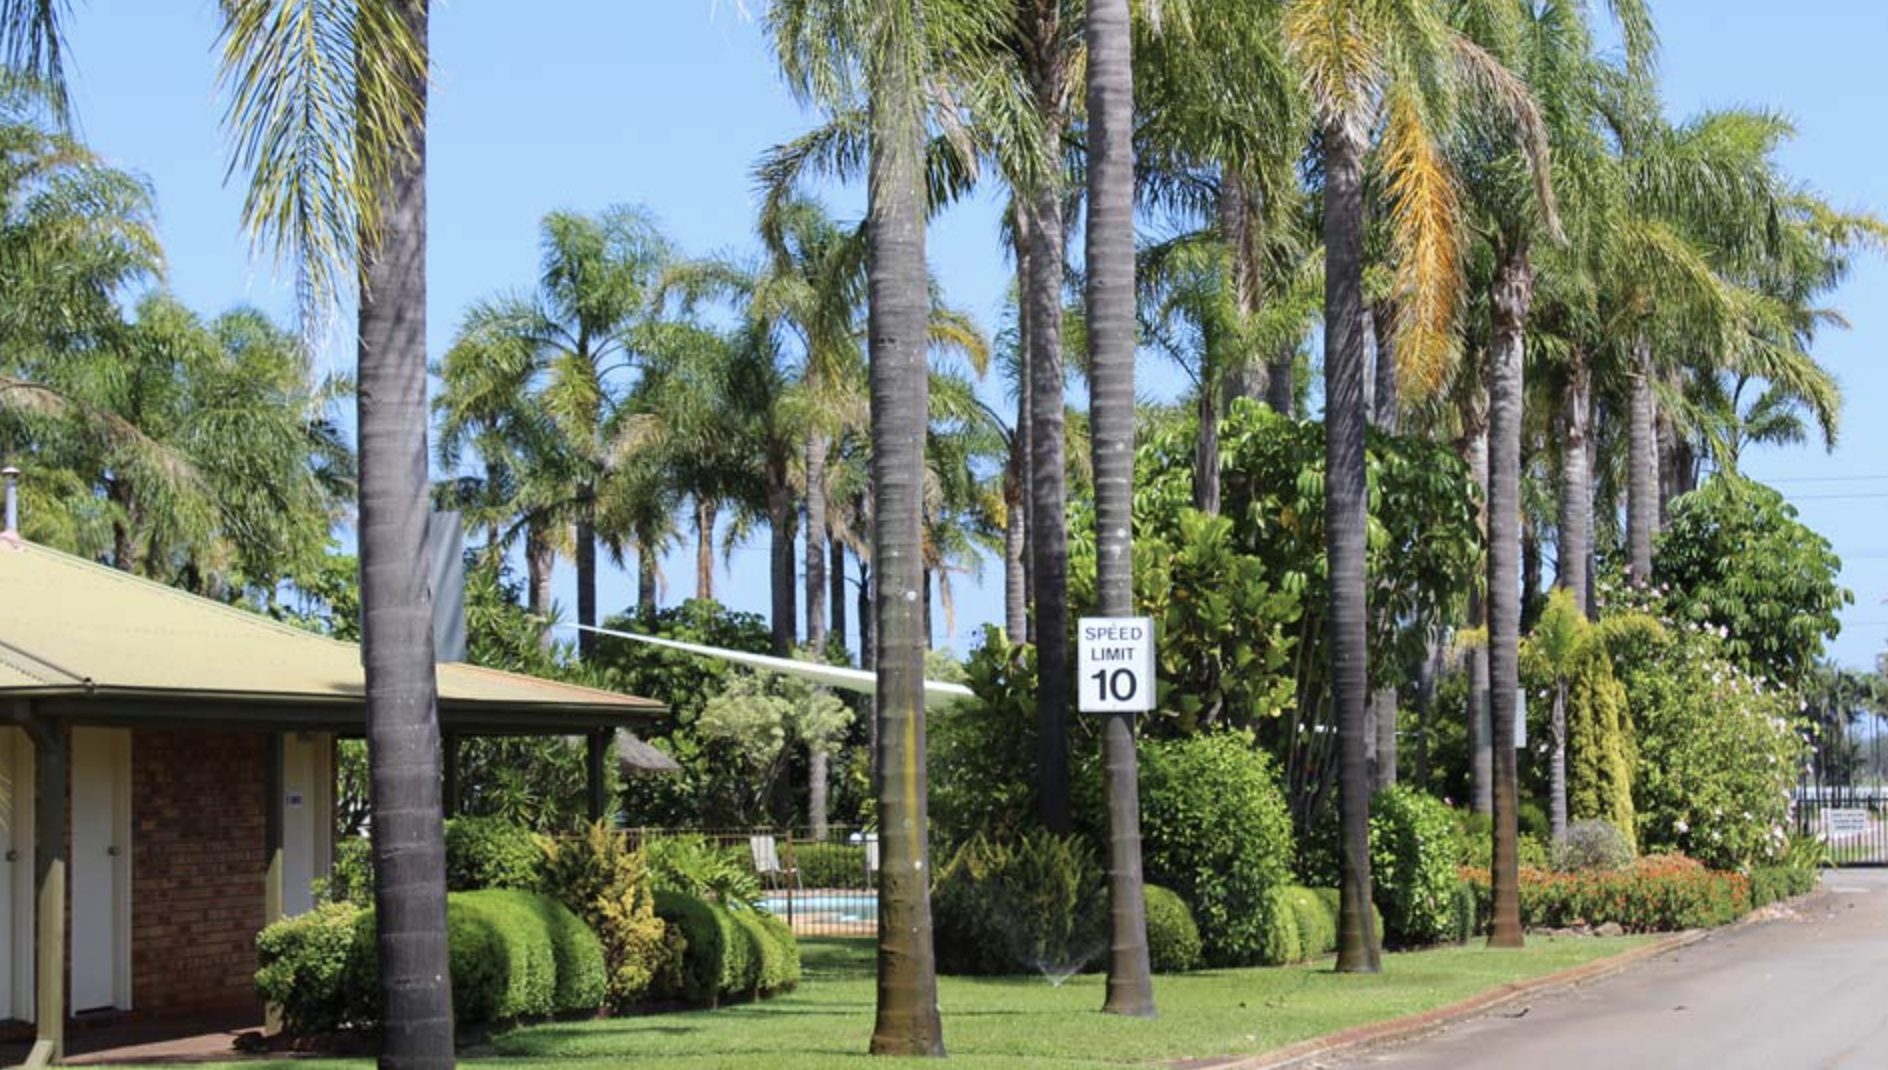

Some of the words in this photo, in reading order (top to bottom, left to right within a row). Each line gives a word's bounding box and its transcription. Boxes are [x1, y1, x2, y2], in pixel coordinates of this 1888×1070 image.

[1085, 627, 1142, 640] SPEED
[1091, 647, 1135, 660] LIMIT
[1091, 668, 1137, 702] 10
